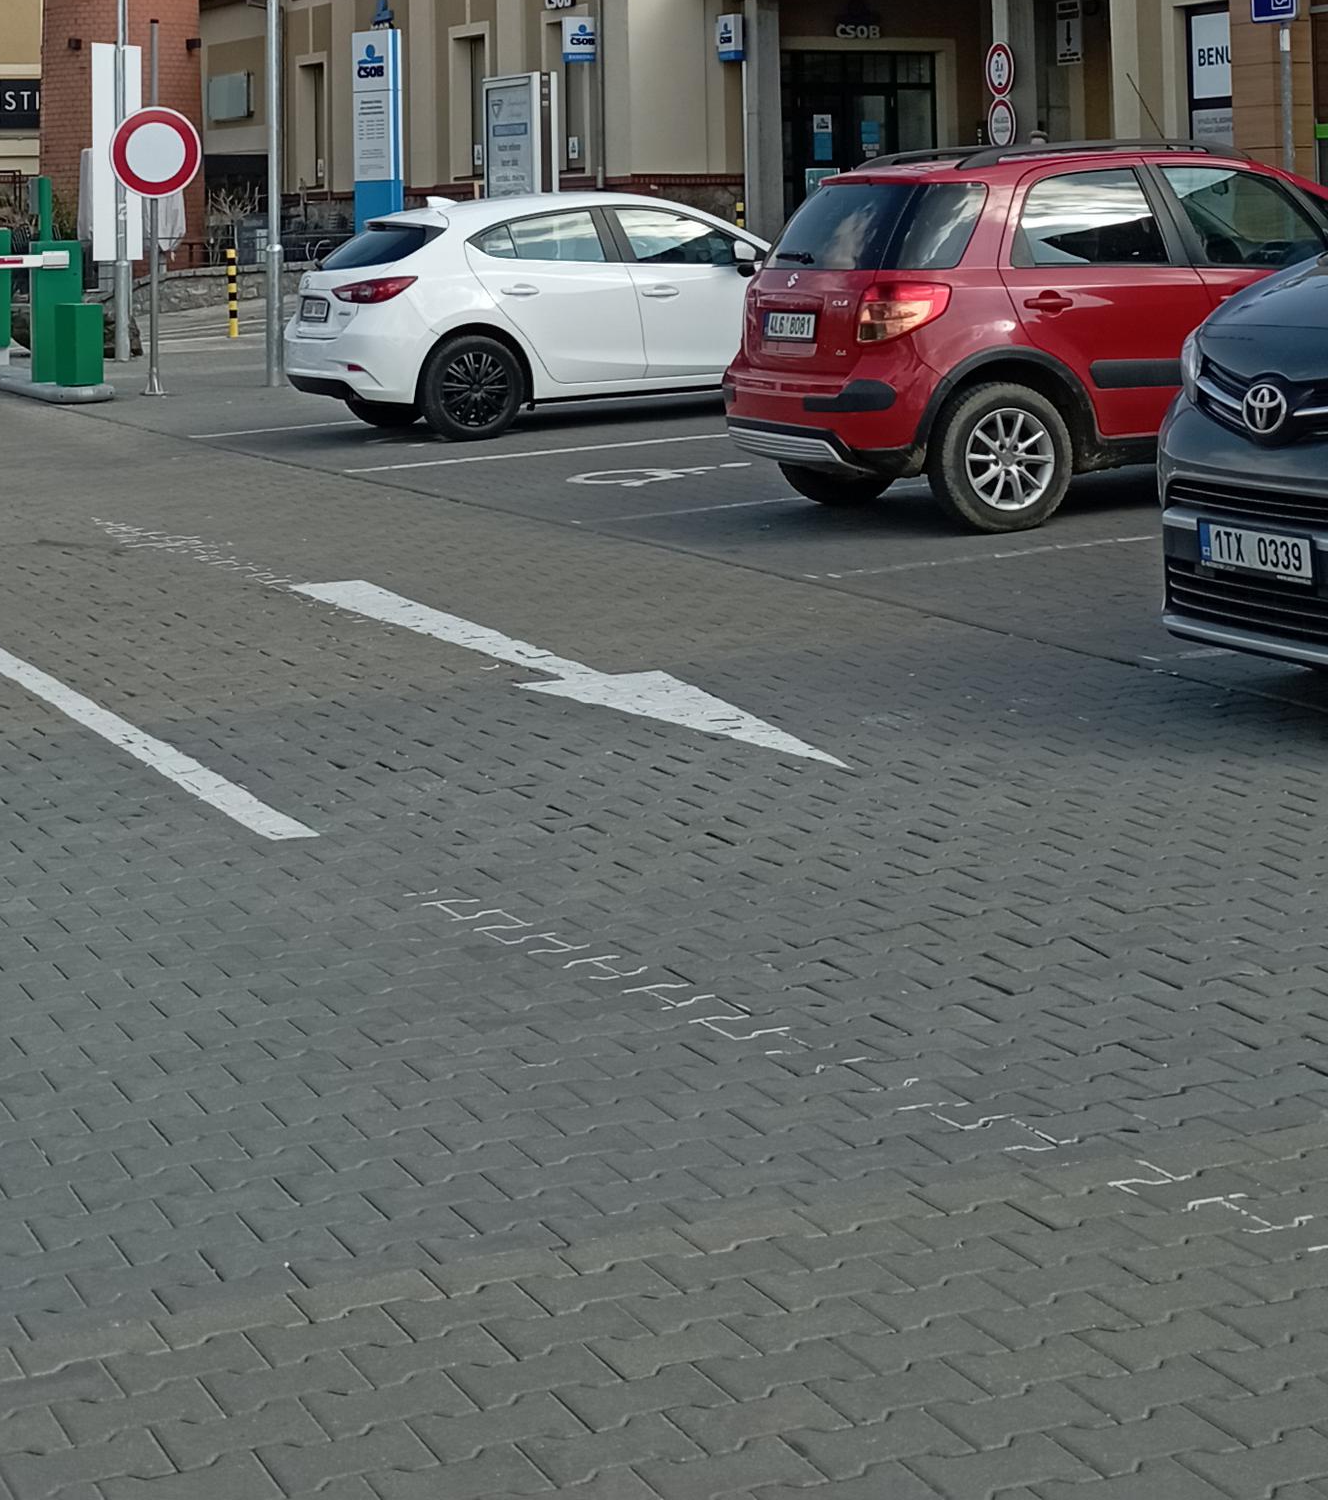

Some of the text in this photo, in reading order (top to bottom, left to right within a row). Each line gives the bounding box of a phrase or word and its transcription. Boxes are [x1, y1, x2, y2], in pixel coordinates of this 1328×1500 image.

[836, 23, 881, 39] ČSOB
[570, 36, 596, 46] ČSOB
[357, 64, 385, 78] ČSOB
[1215, 530, 1302, 572] 1TX 0339
